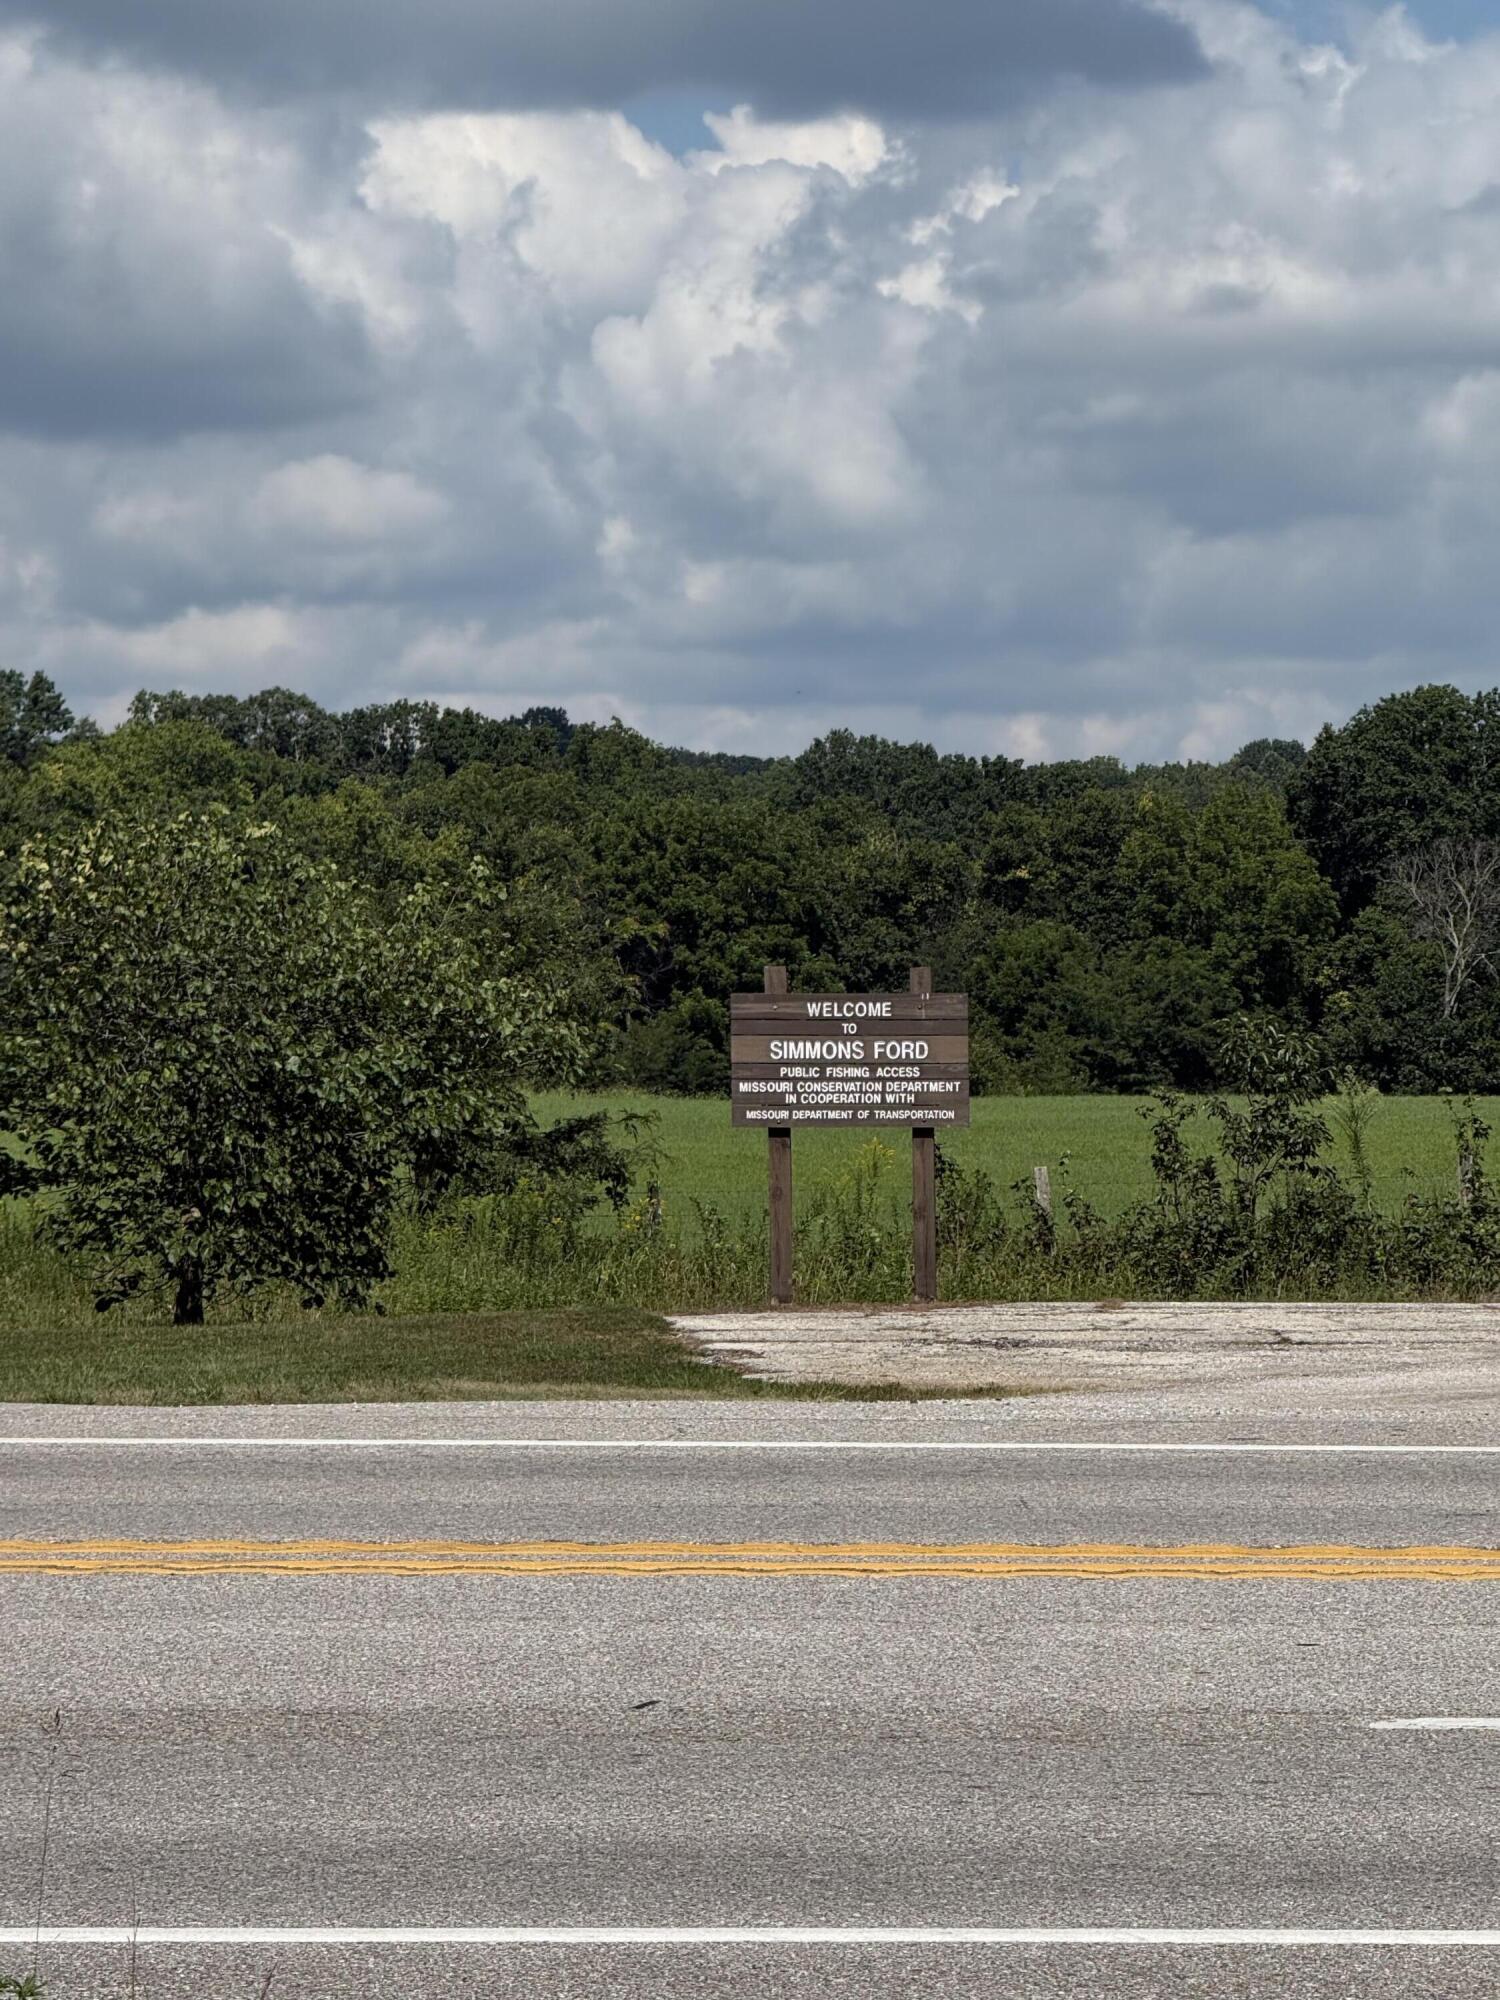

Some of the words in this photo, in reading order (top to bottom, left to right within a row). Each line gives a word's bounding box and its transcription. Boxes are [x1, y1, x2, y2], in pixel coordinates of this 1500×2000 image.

[807, 1001, 892, 1017] WELCOME
[841, 1023, 857, 1034] TO
[770, 1040, 865, 1059] SIMMONS
[873, 1041, 929, 1059] FORD
[780, 1067, 820, 1077] PUBLIC
[826, 1067, 870, 1077] FISHING
[876, 1067, 920, 1077] ACCESS
[739, 1081, 793, 1092] MISSOURI
[797, 1081, 882, 1092] CONSERVATION
[886, 1081, 961, 1092] DEPARTMENT
[785, 1093, 797, 1104] IN
[801, 1093, 881, 1104] COOPERATION
[885, 1093, 915, 1104] WITH
[746, 1110, 789, 1120] MISSOURI
[792, 1110, 853, 1120] DEPARTMENT
[857, 1110, 870, 1120] OF
[874, 1110, 955, 1120] TRANSPORTATION
